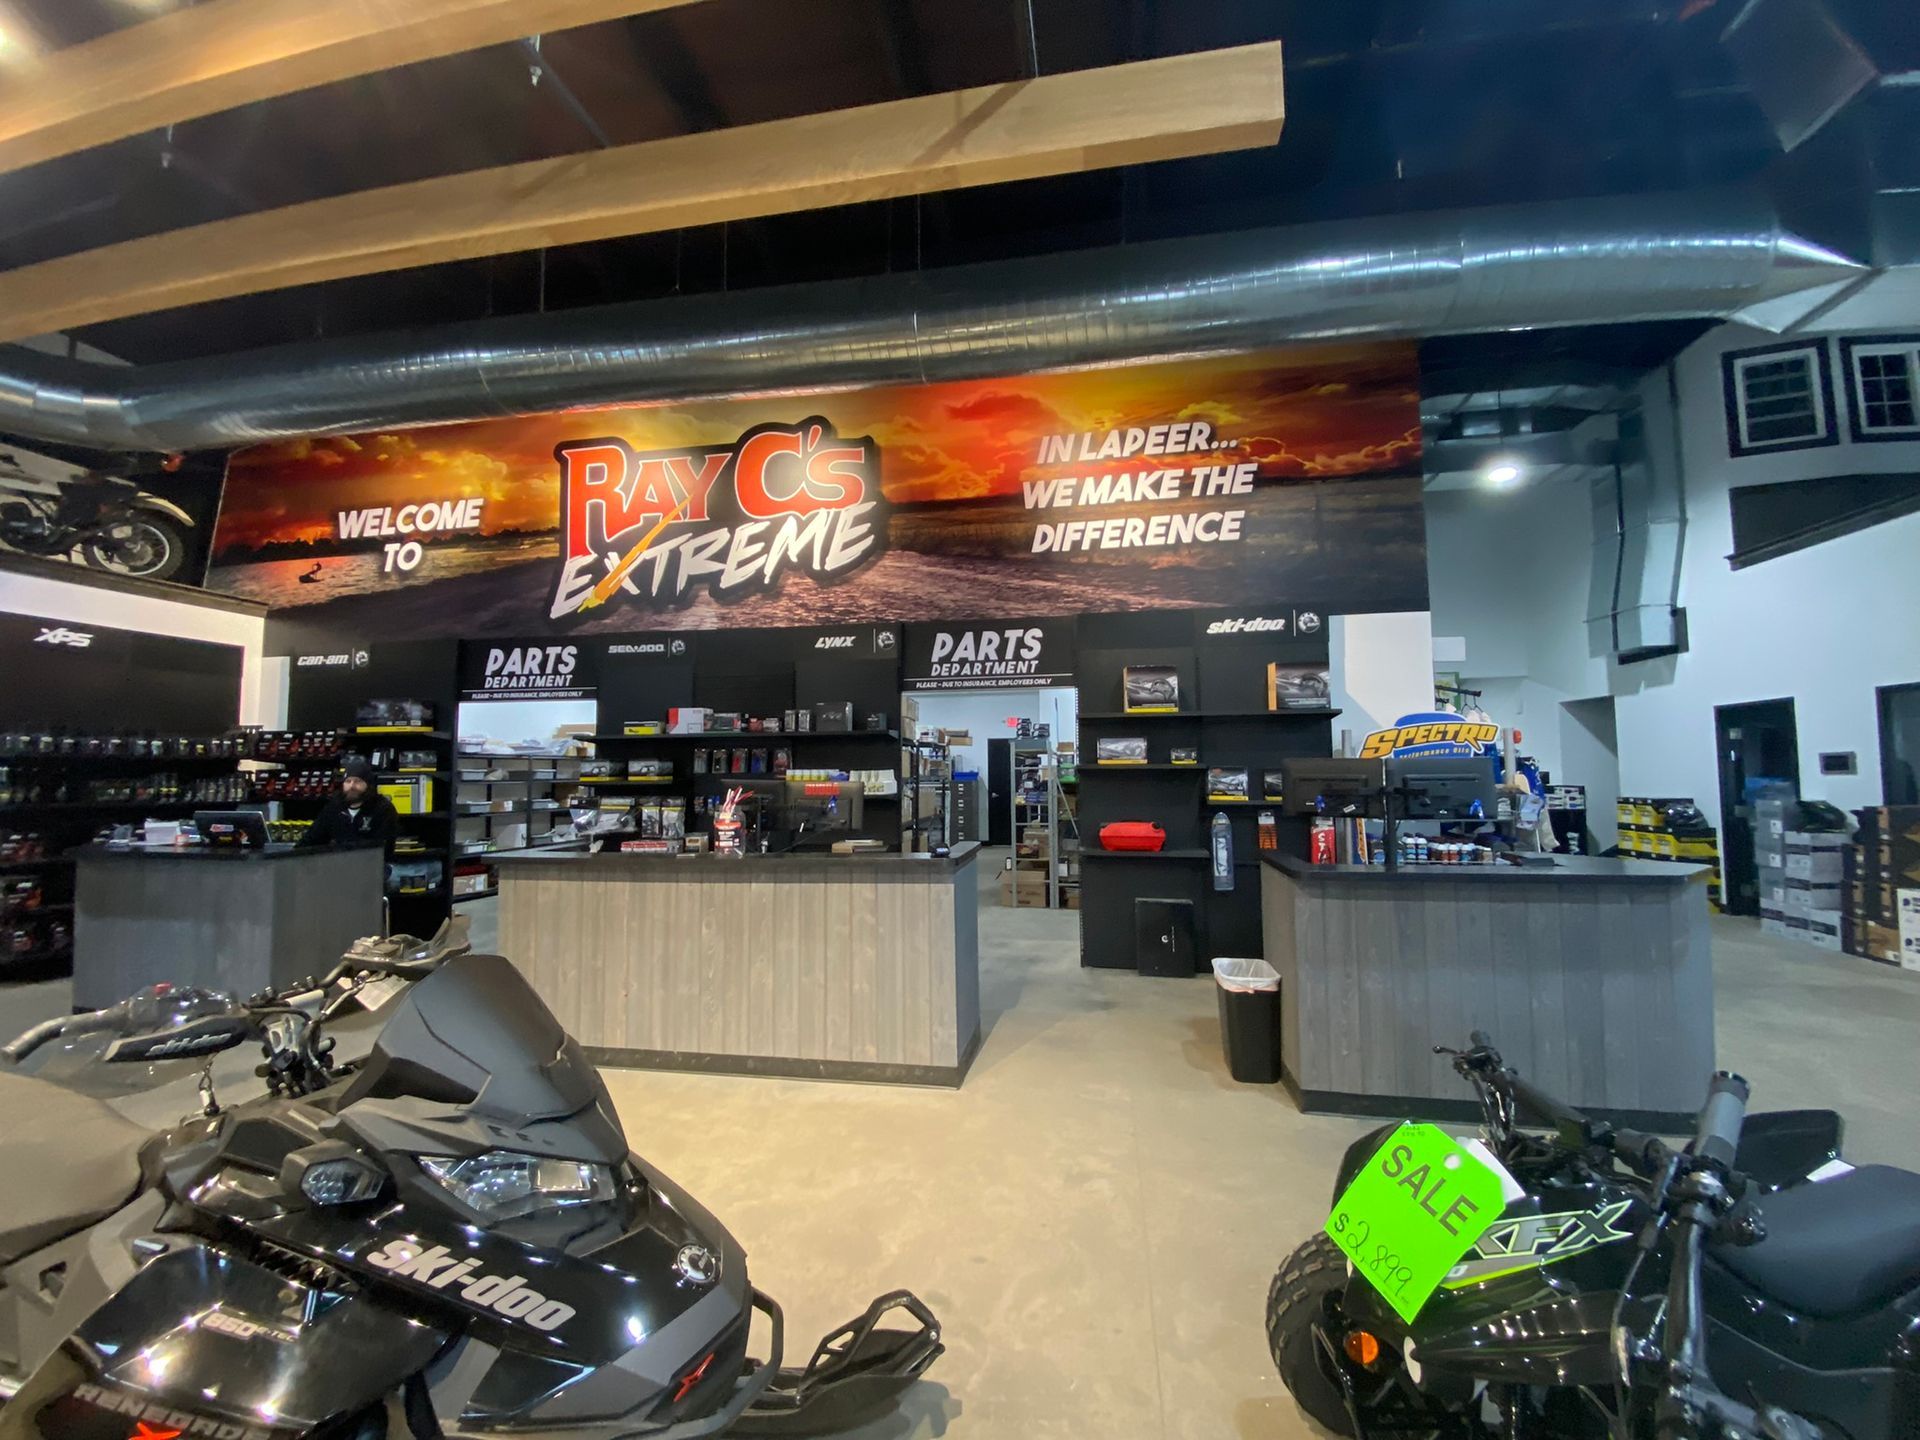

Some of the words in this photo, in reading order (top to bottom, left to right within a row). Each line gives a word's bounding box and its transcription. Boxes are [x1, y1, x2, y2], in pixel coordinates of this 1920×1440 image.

[1036, 432, 1076, 464] IN
[1078, 421, 1238, 461] LAPEER...
[561, 444, 733, 558] RAY
[1022, 478, 1076, 509] WE
[1078, 468, 1184, 506] MAKE
[1189, 462, 1258, 497] THE
[338, 499, 483, 538] WELCOME
[1031, 510, 1246, 553] DIFFERENCE
[383, 541, 423, 573] TO
[549, 501, 877, 620] EXTREME
[33, 627, 95, 648] XPS
[815, 635, 857, 649] LYNX
[1206, 617, 1286, 635] ski-doo
[484, 645, 578, 675] PARTS
[930, 627, 1044, 663] PARTS
[484, 674, 574, 689] DEPARTMENT
[930, 660, 1039, 677] DEPARTMENT
[1360, 723, 1497, 758] SPECTRO
[1381, 1144, 1479, 1237] SALE
[366, 1239, 576, 1332] ski-doo
